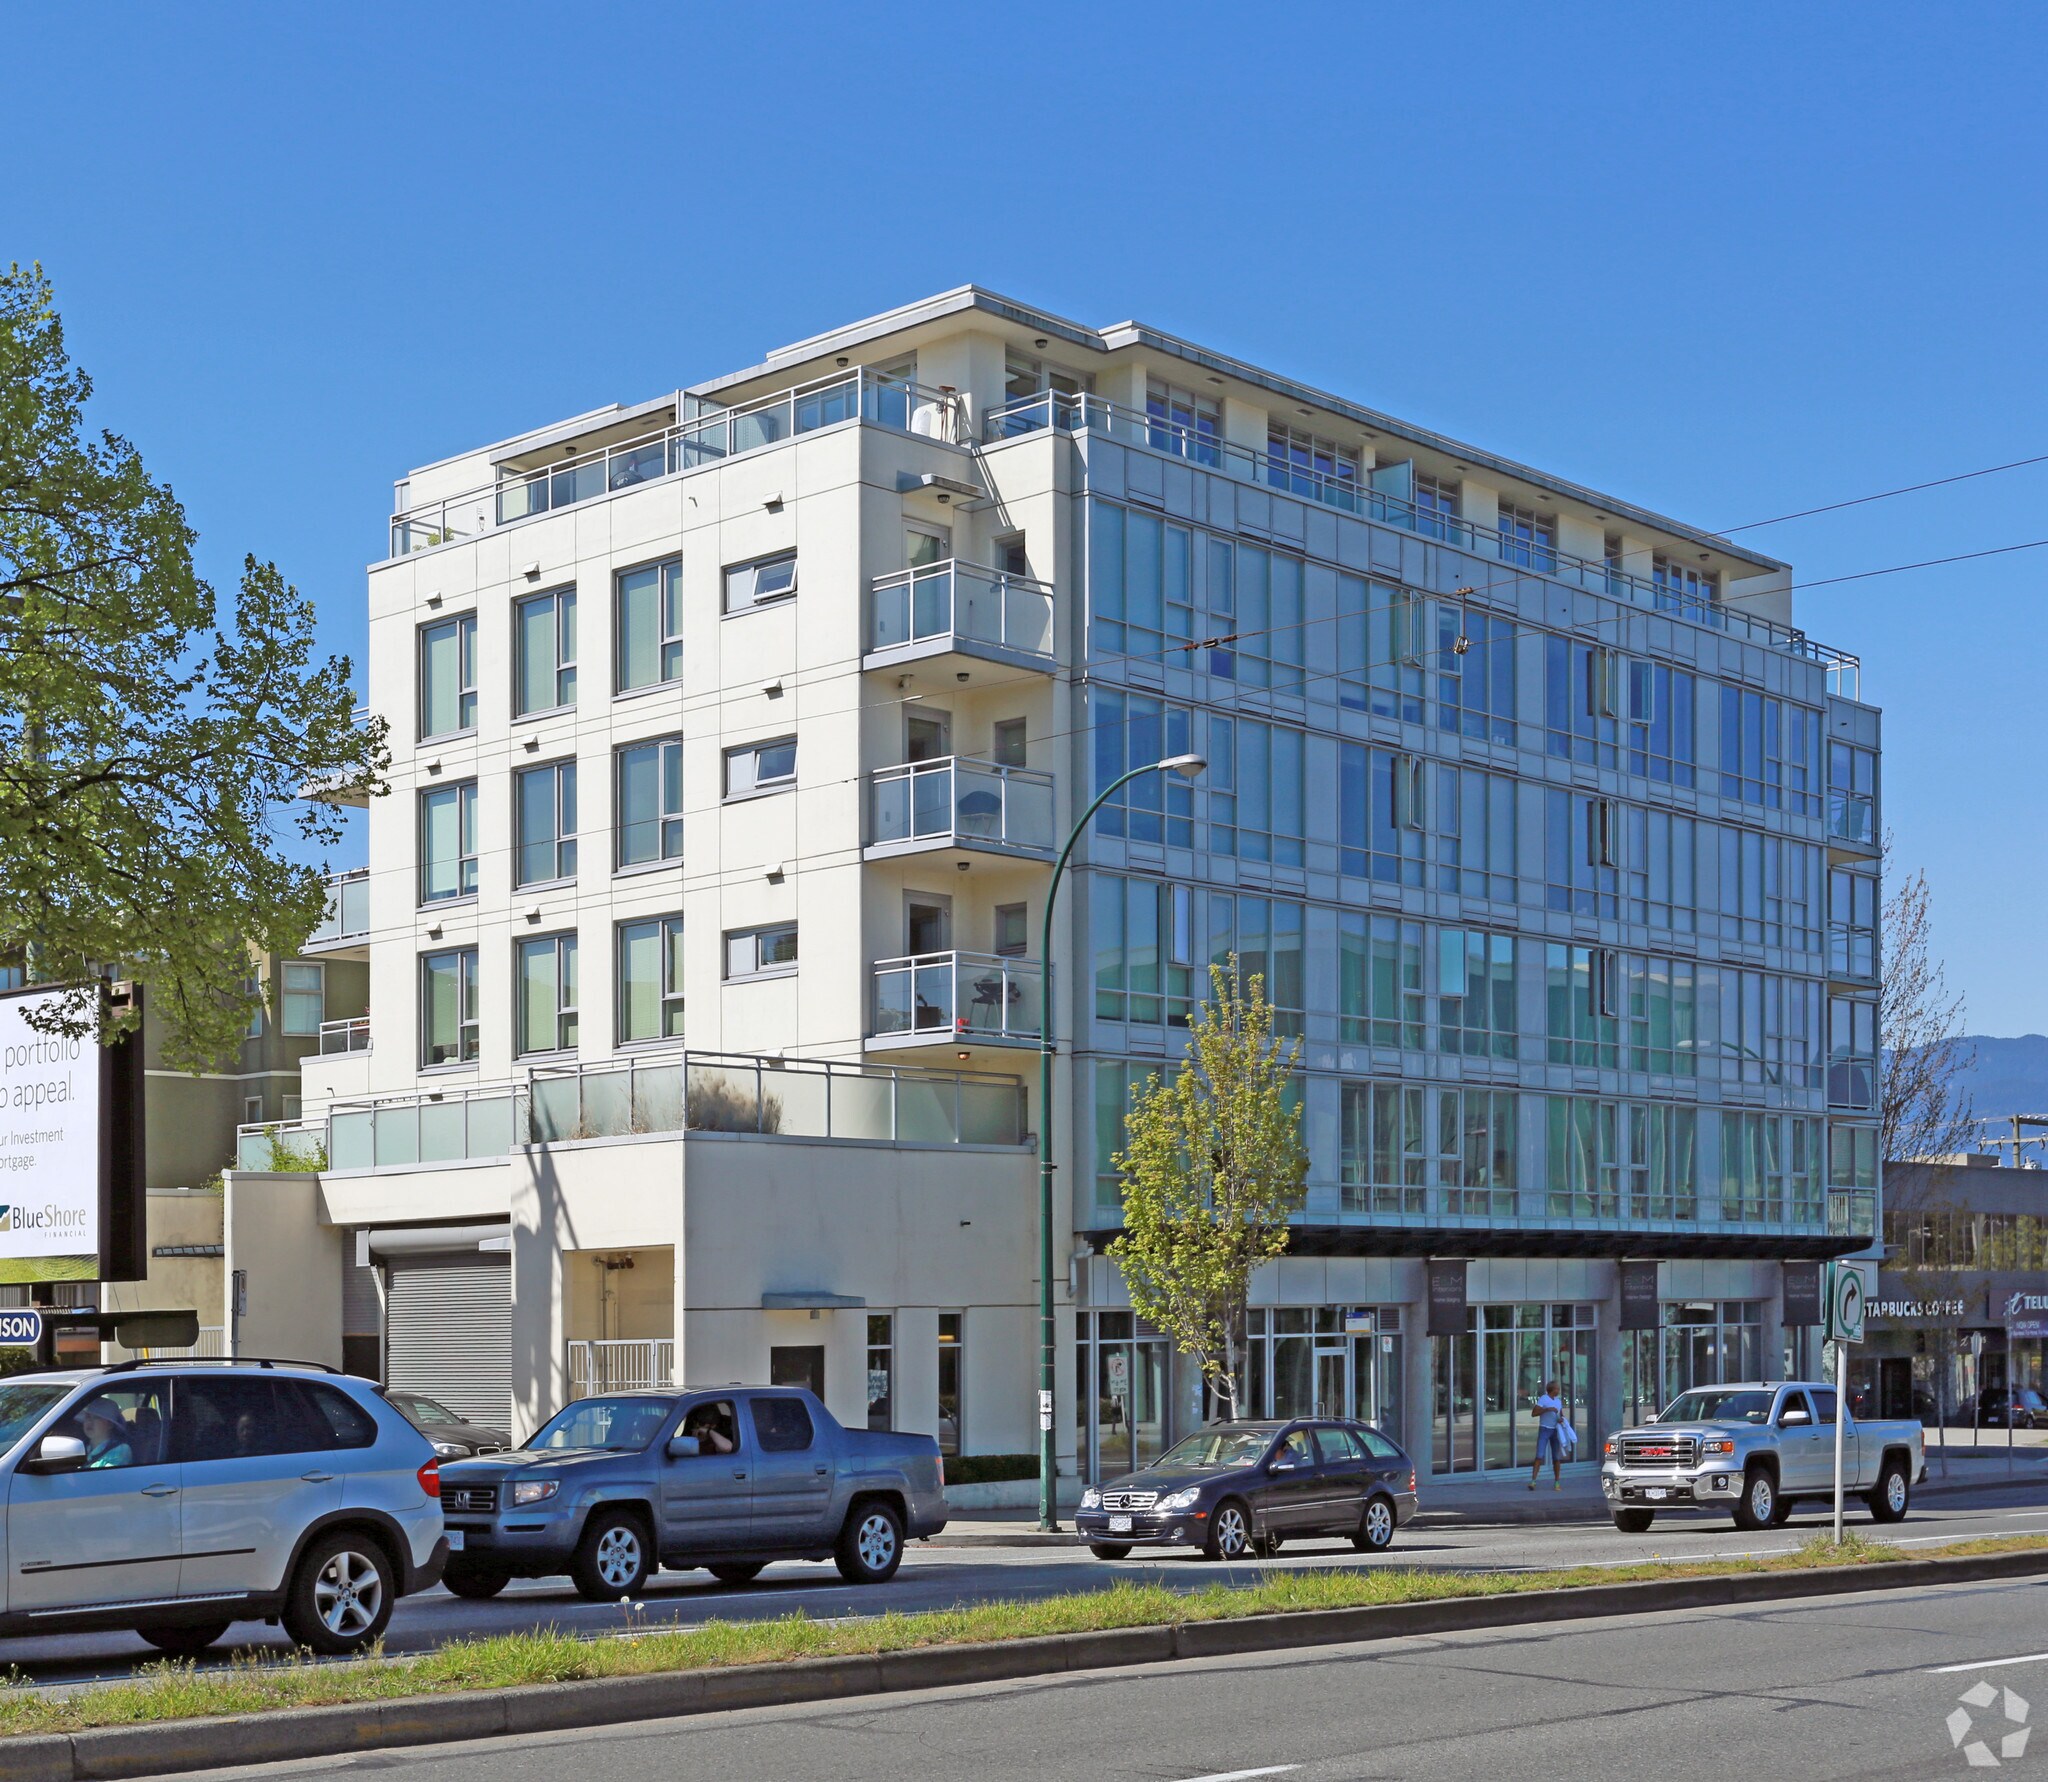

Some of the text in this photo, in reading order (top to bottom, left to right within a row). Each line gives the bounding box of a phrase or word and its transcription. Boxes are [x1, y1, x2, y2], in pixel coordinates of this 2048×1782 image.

[5, 1031, 81, 1075] portfolio
[13, 1070, 75, 1113] appeal.
[10, 1127, 64, 1146] Investment
[12, 1204, 87, 1230] BlueShore
[44, 1230, 87, 1238] FINANCIAL
[1640, 1447, 1672, 1457] GMC
